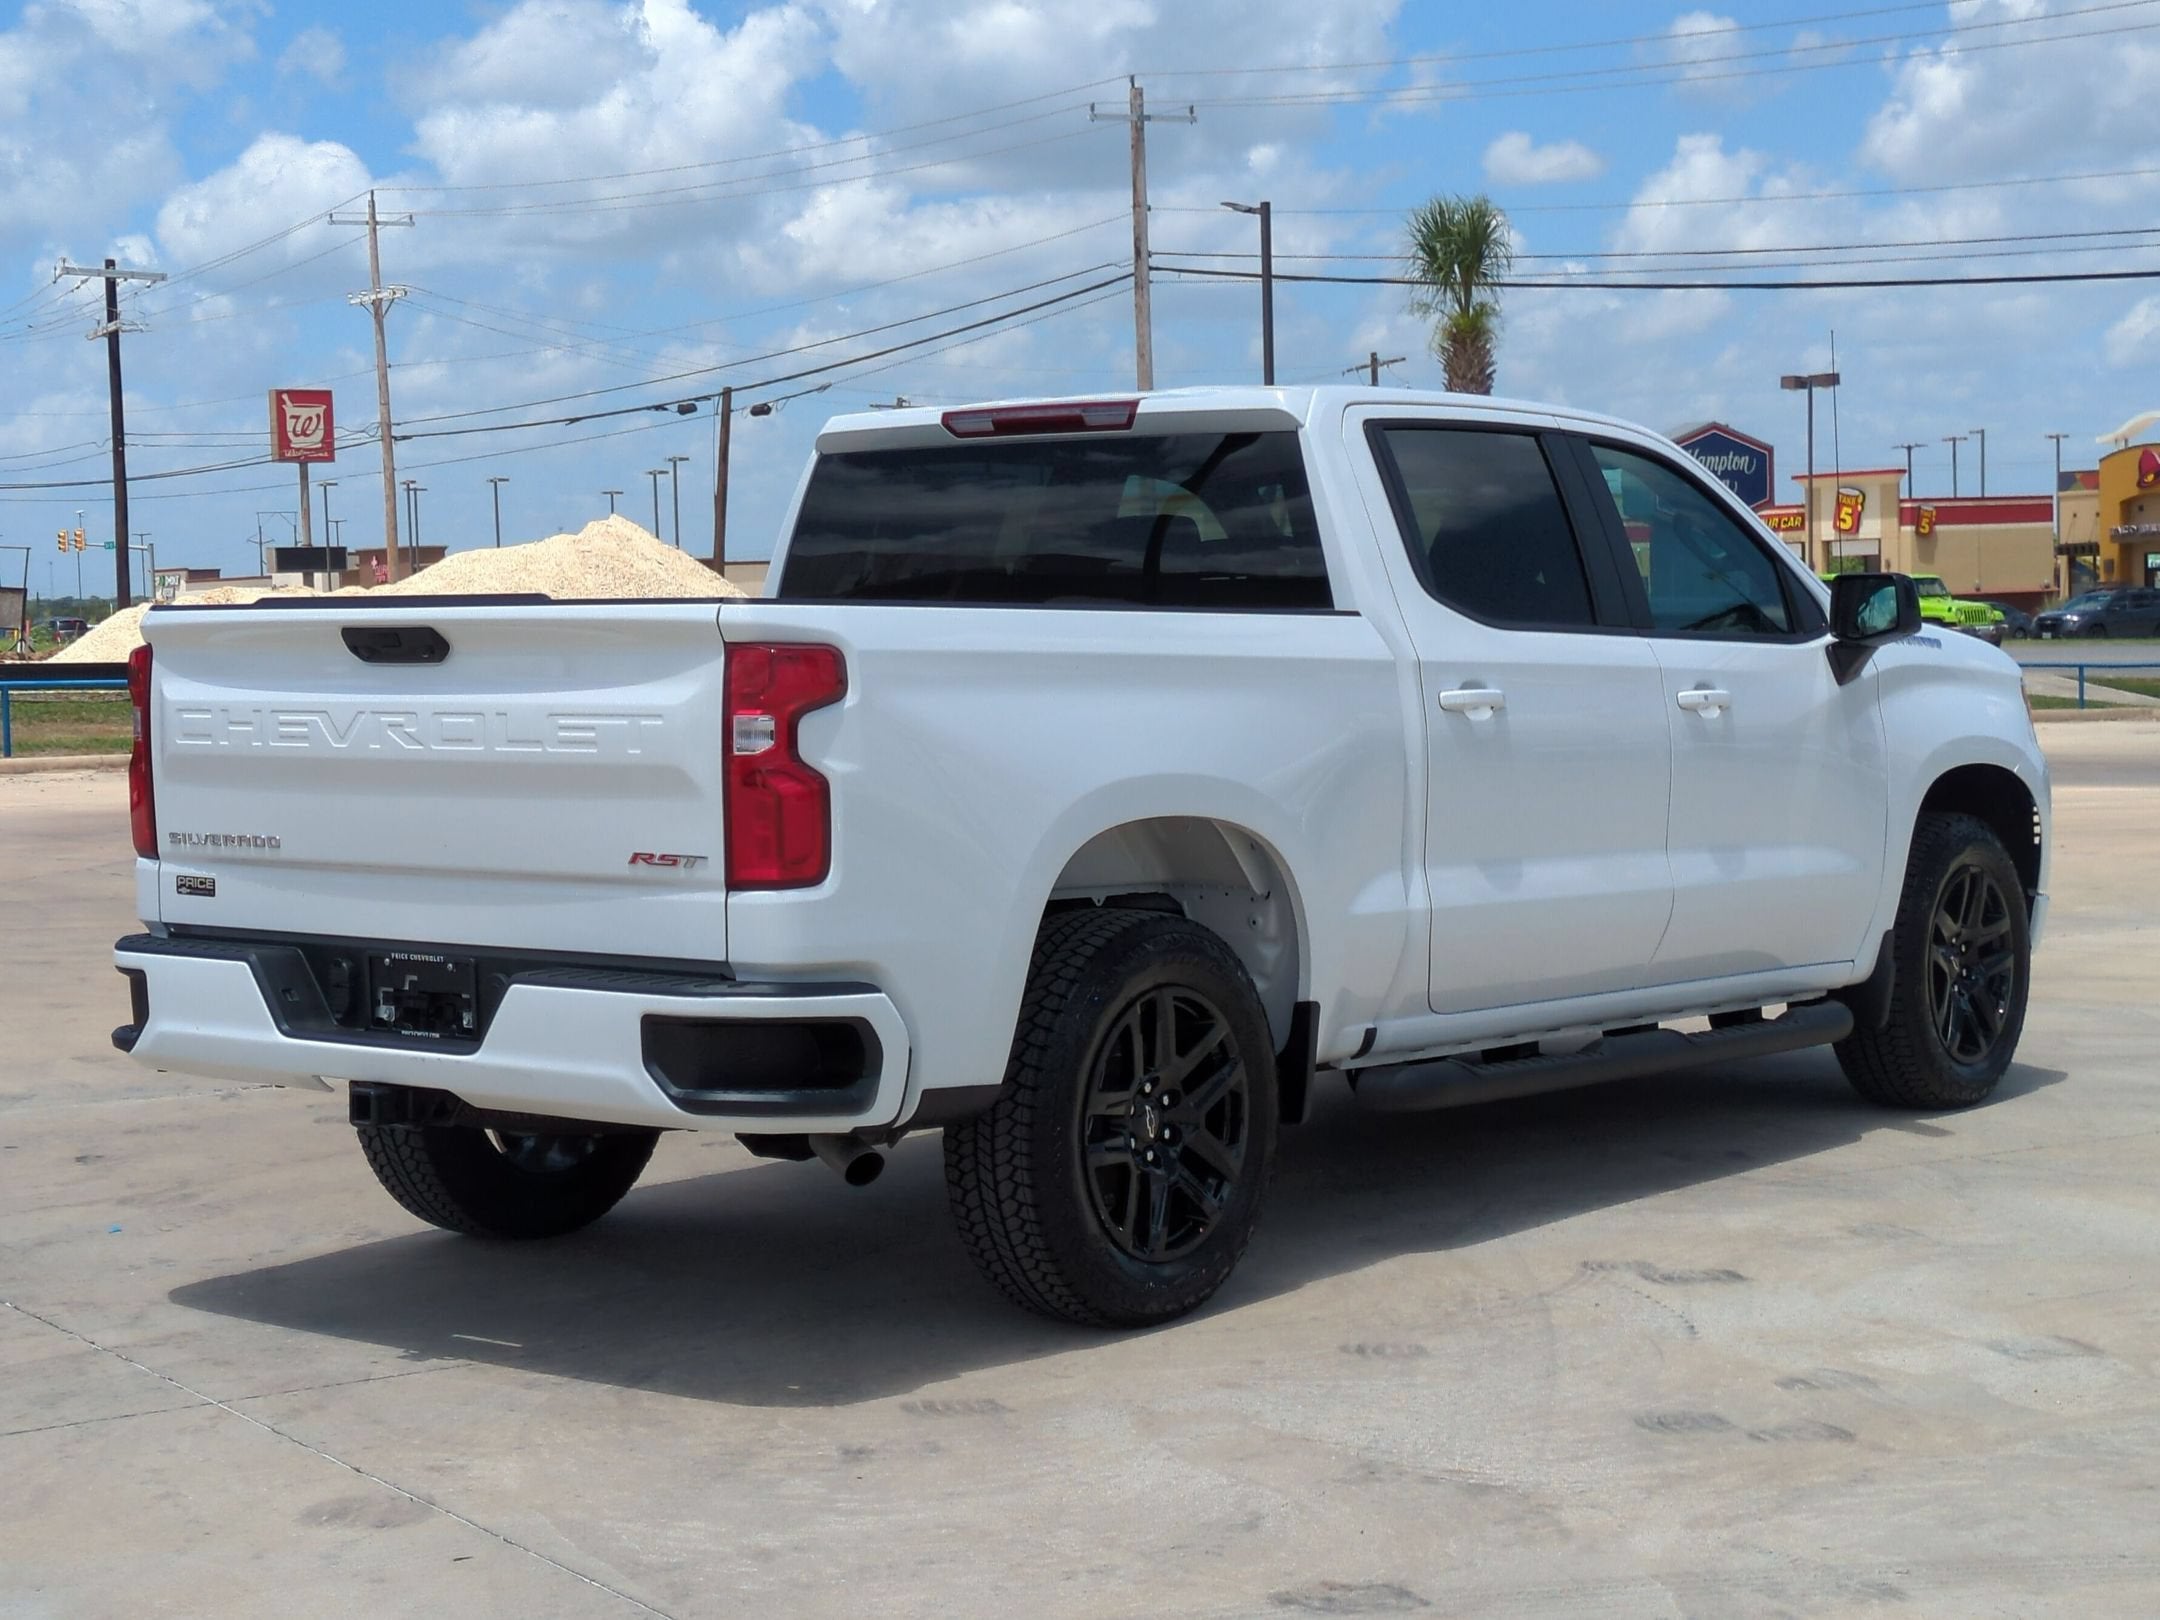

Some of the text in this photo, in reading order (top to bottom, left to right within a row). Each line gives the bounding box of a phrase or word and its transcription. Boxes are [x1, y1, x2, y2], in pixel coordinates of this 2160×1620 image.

[1780, 516, 1802, 529] CAR
[1836, 506, 1853, 530] 5
[1919, 517, 1930, 534] 5
[175, 708, 664, 754] CHEVROLET
[168, 831, 281, 849] SILVERADO
[628, 851, 709, 869] RST
[177, 876, 214, 890] PRICE
[391, 952, 444, 963] PRICE CHEVROLET
